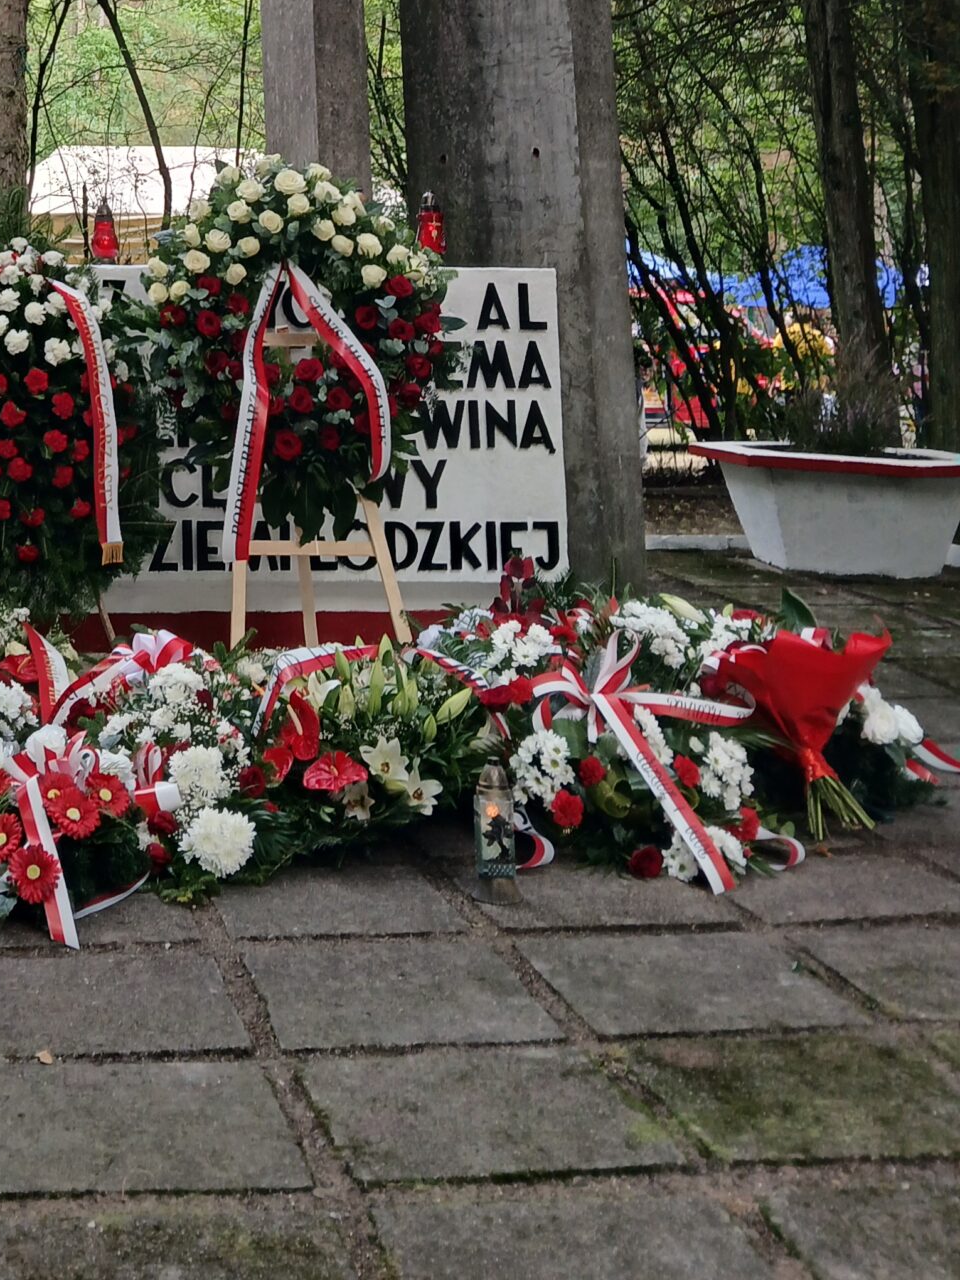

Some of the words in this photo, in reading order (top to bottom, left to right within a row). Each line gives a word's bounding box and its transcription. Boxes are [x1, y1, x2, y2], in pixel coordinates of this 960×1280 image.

[477, 282, 548, 331] AL
[71, 295, 106, 388] DZIMIERZ
[418, 399, 557, 455] WINĄ
